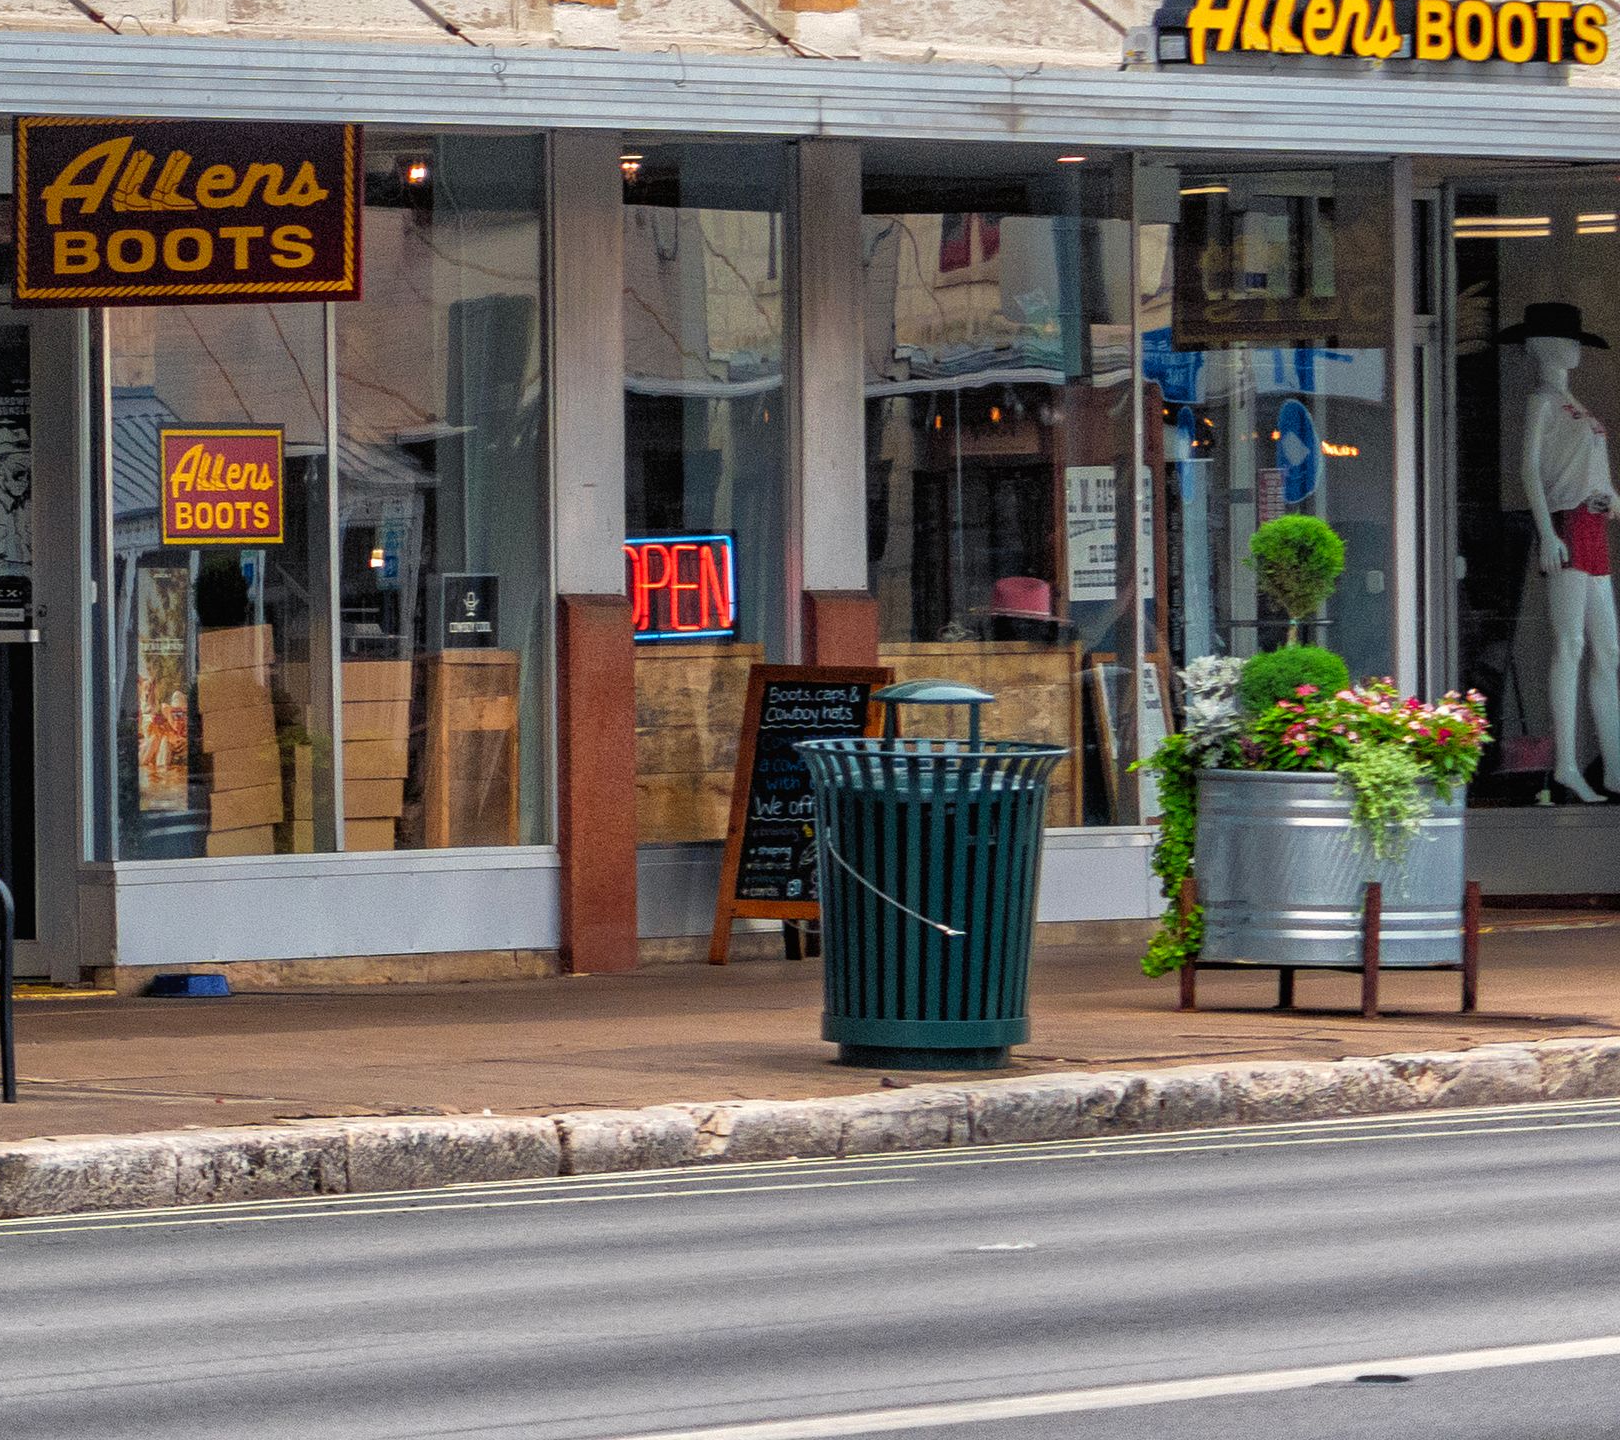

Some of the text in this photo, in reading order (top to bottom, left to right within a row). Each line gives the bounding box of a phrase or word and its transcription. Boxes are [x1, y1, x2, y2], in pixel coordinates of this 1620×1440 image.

[41, 135, 329, 225] Allens
[54, 224, 315, 274] BOOTS
[170, 443, 274, 499] Allens
[175, 500, 271, 530] BOOTS
[765, 706, 854, 725] Cowboy hats
[754, 796, 817, 817] We off
